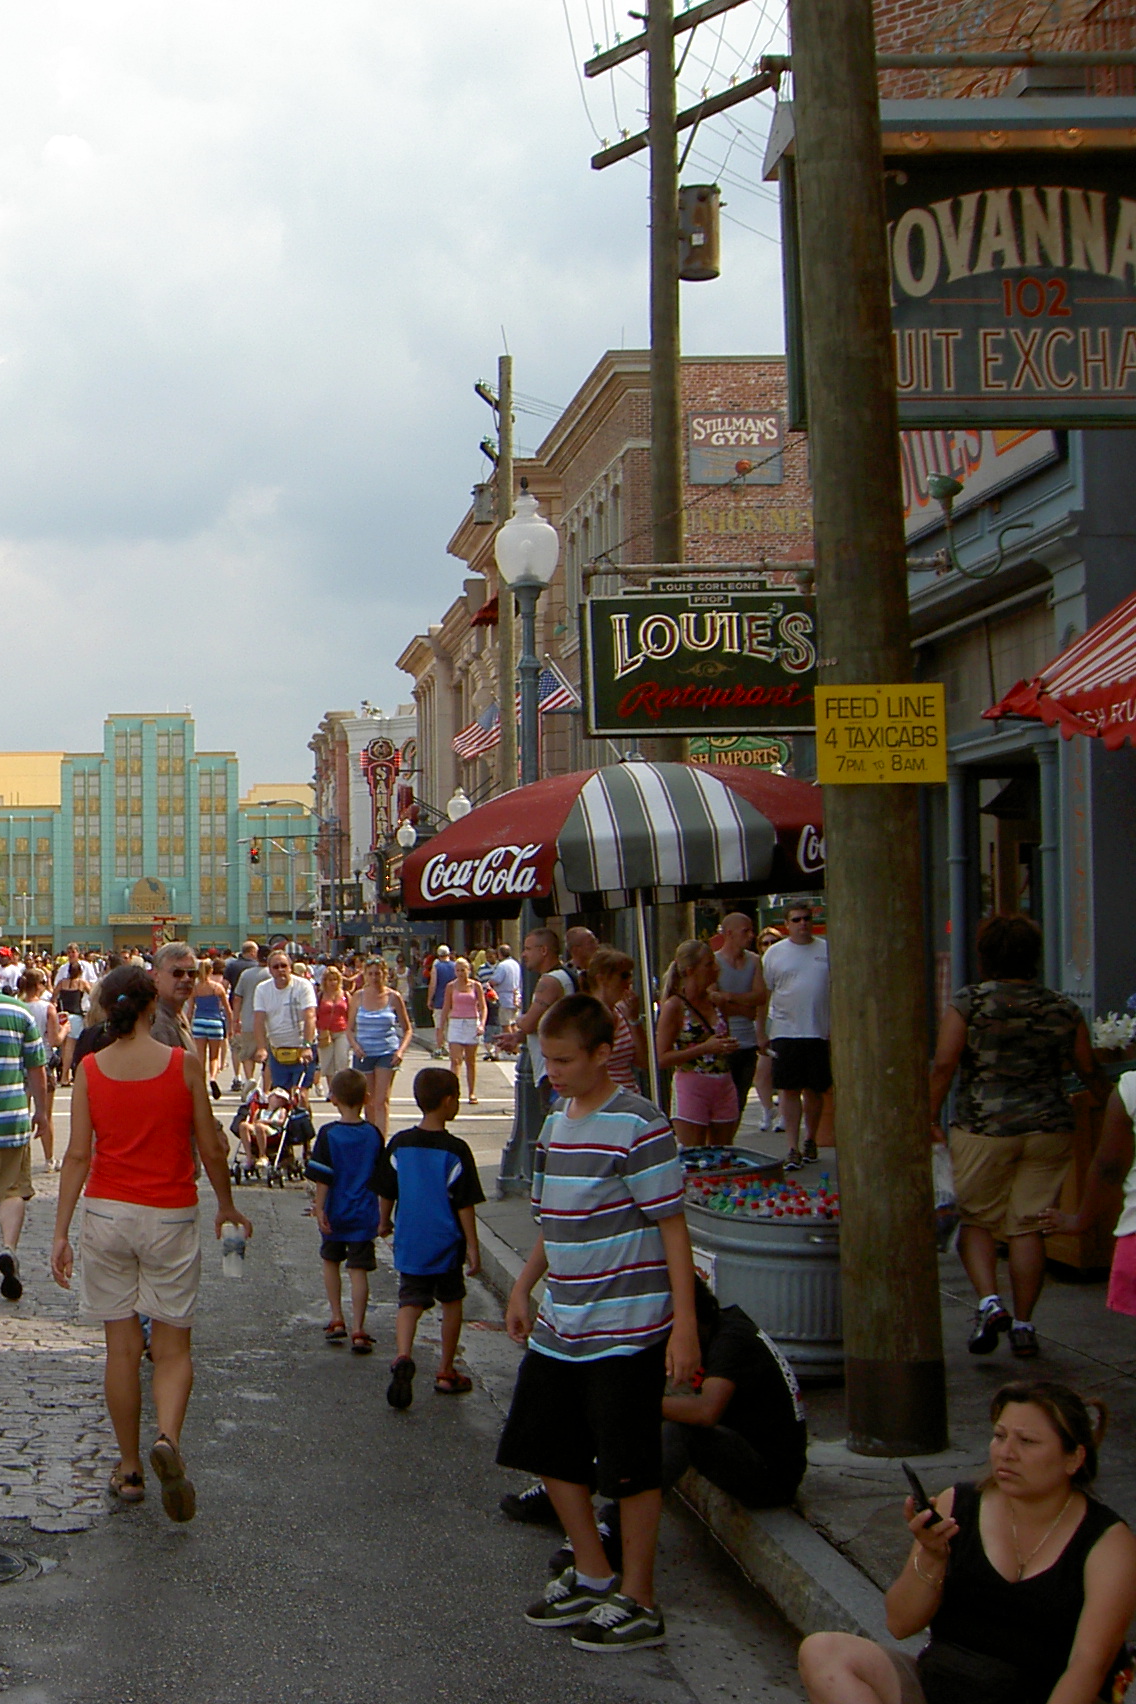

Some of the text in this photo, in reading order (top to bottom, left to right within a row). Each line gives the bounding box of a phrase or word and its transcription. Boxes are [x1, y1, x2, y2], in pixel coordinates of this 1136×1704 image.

[1002, 277, 1072, 318] 102
[692, 416, 778, 441] STILLMAN'S
[710, 432, 760, 446] GYM
[659, 580, 760, 592] LOUIS CORLEONE
[693, 595, 727, 604] PROP.
[609, 602, 816, 682] LOUIE'S
[617, 681, 813, 720] Restaurant
[825, 695, 935, 719] FEED LINE
[824, 725, 939, 749] 4 TAXICABS
[715, 745, 780, 765] IMPORTS
[872, 760, 885, 771] TO
[421, 843, 544, 901] Coca-Cola
[371, 925, 413, 934] Ice Crea
